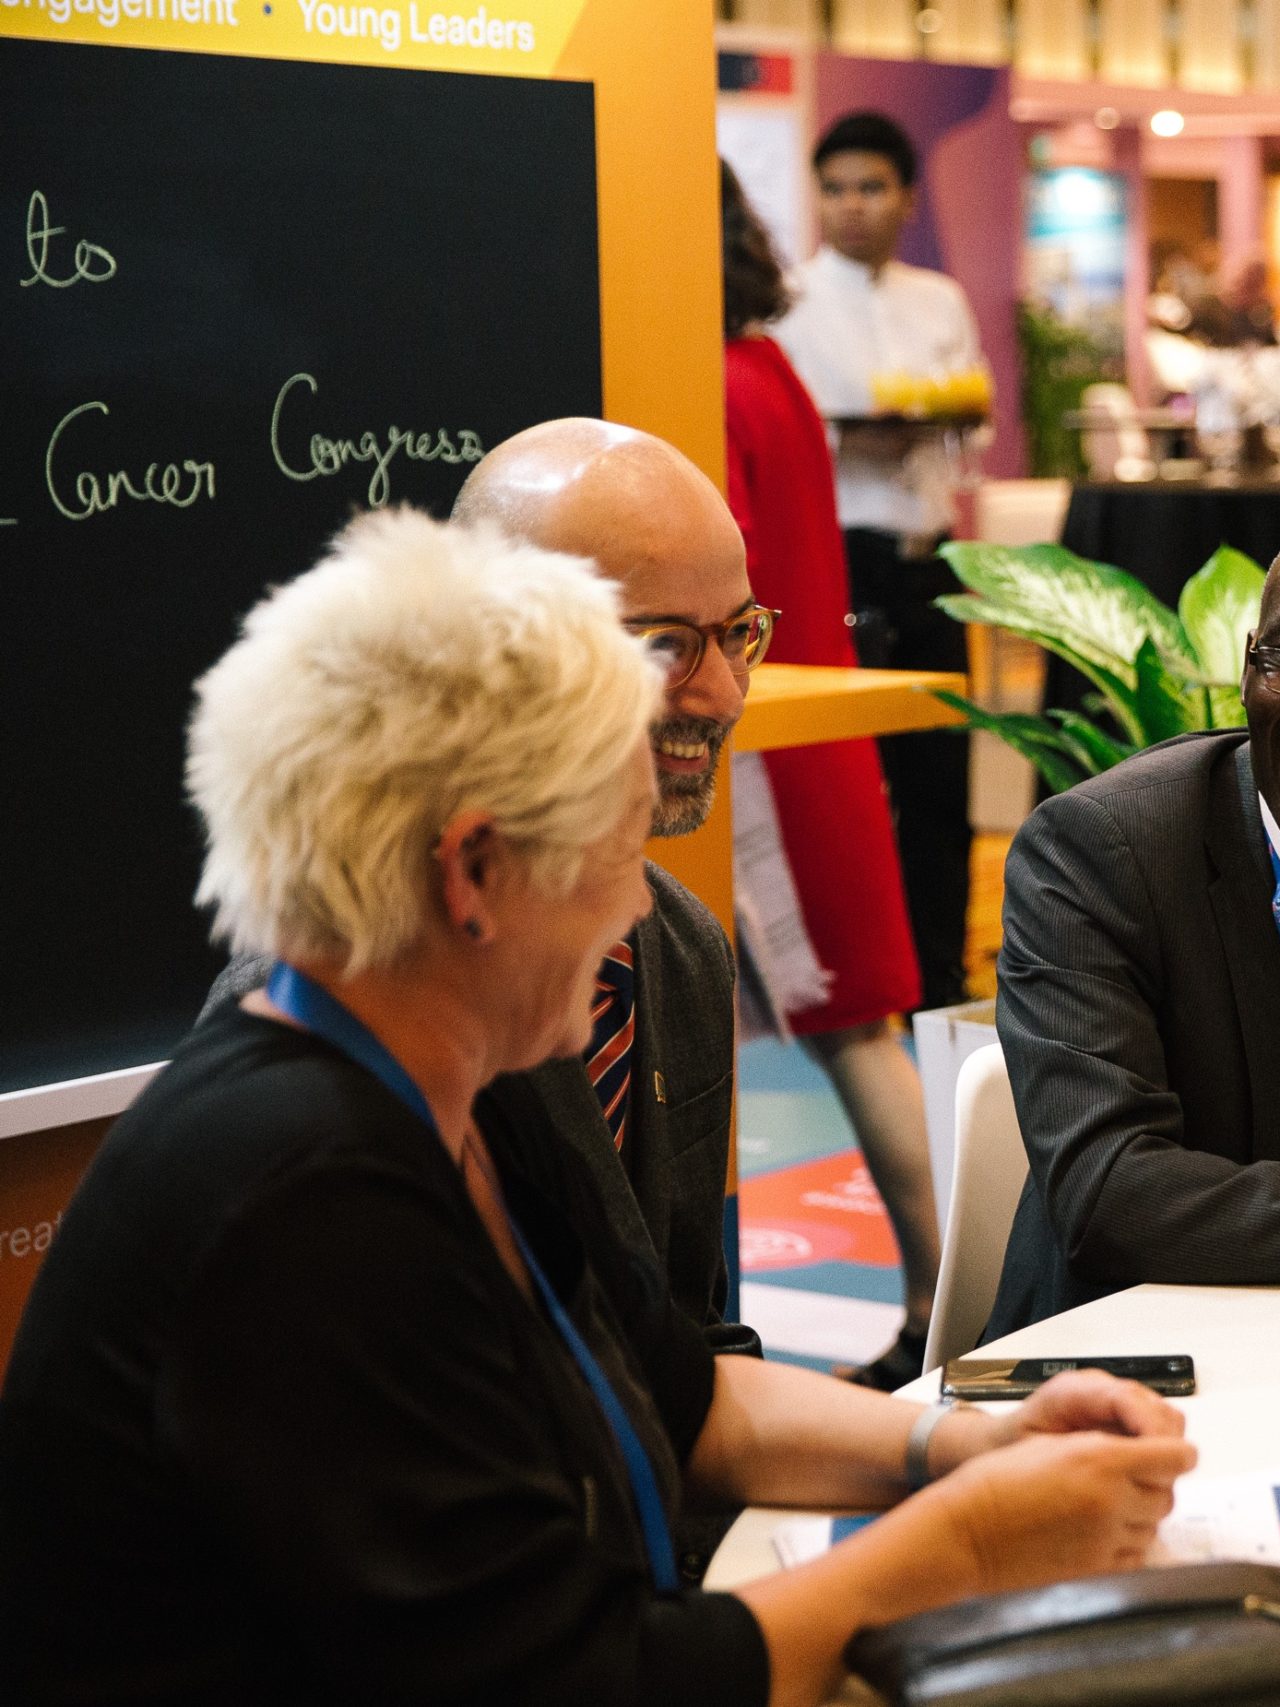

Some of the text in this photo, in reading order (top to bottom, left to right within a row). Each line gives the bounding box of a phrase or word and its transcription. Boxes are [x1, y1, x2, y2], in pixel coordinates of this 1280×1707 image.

[0, 0, 536, 52] gagement Young Leaders
[20, 190, 117, 288] to
[46, 373, 487, 520] Cancer Congress
